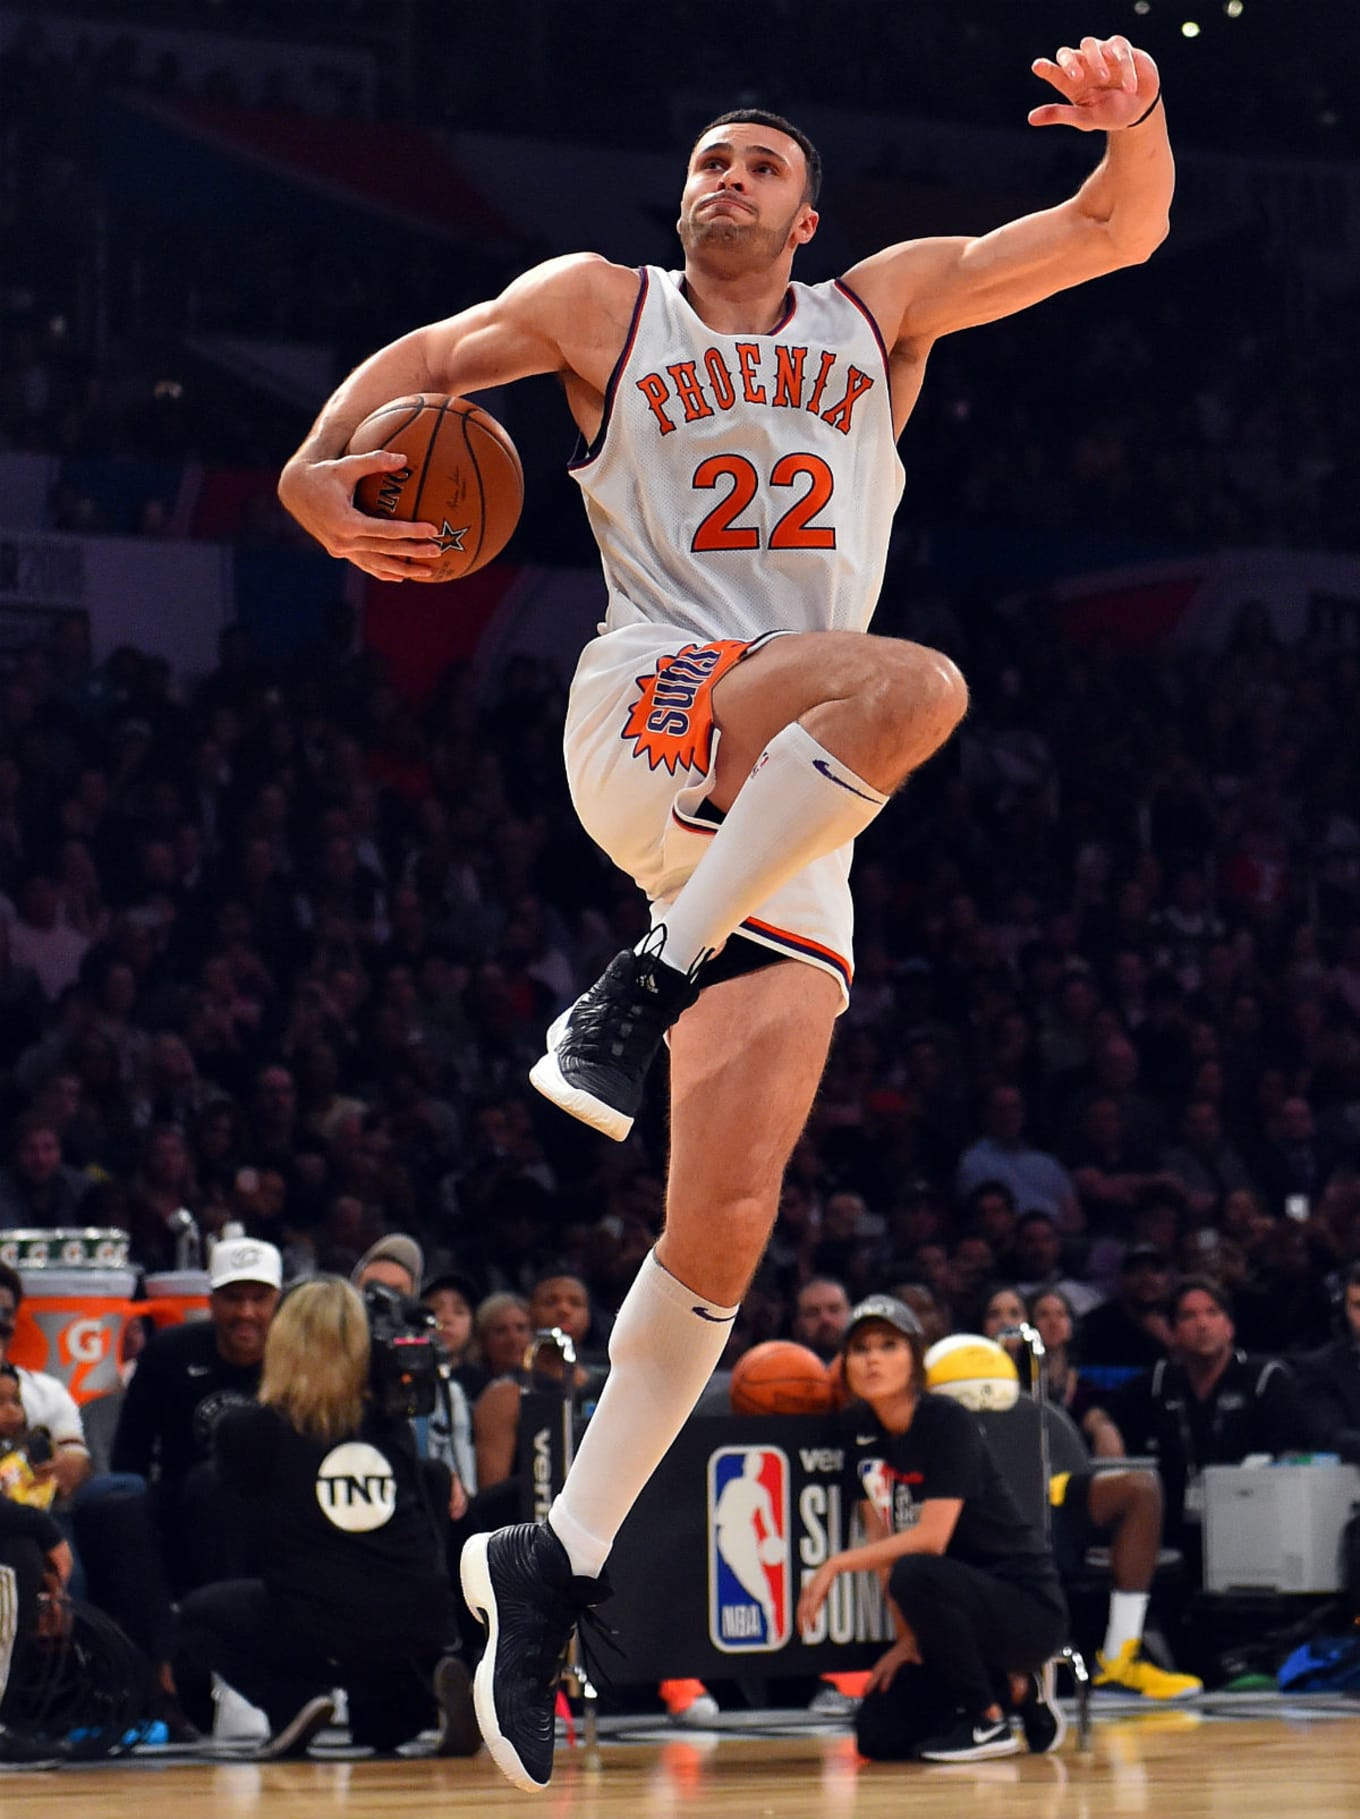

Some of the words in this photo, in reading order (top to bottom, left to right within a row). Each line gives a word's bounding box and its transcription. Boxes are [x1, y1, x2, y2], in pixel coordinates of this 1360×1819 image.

[636, 341, 875, 436] PHOENIX
[691, 451, 837, 552] 22
[66, 1319, 104, 1362] G
[317, 1473, 394, 1506] TNT
[721, 1604, 762, 1638] NBA
